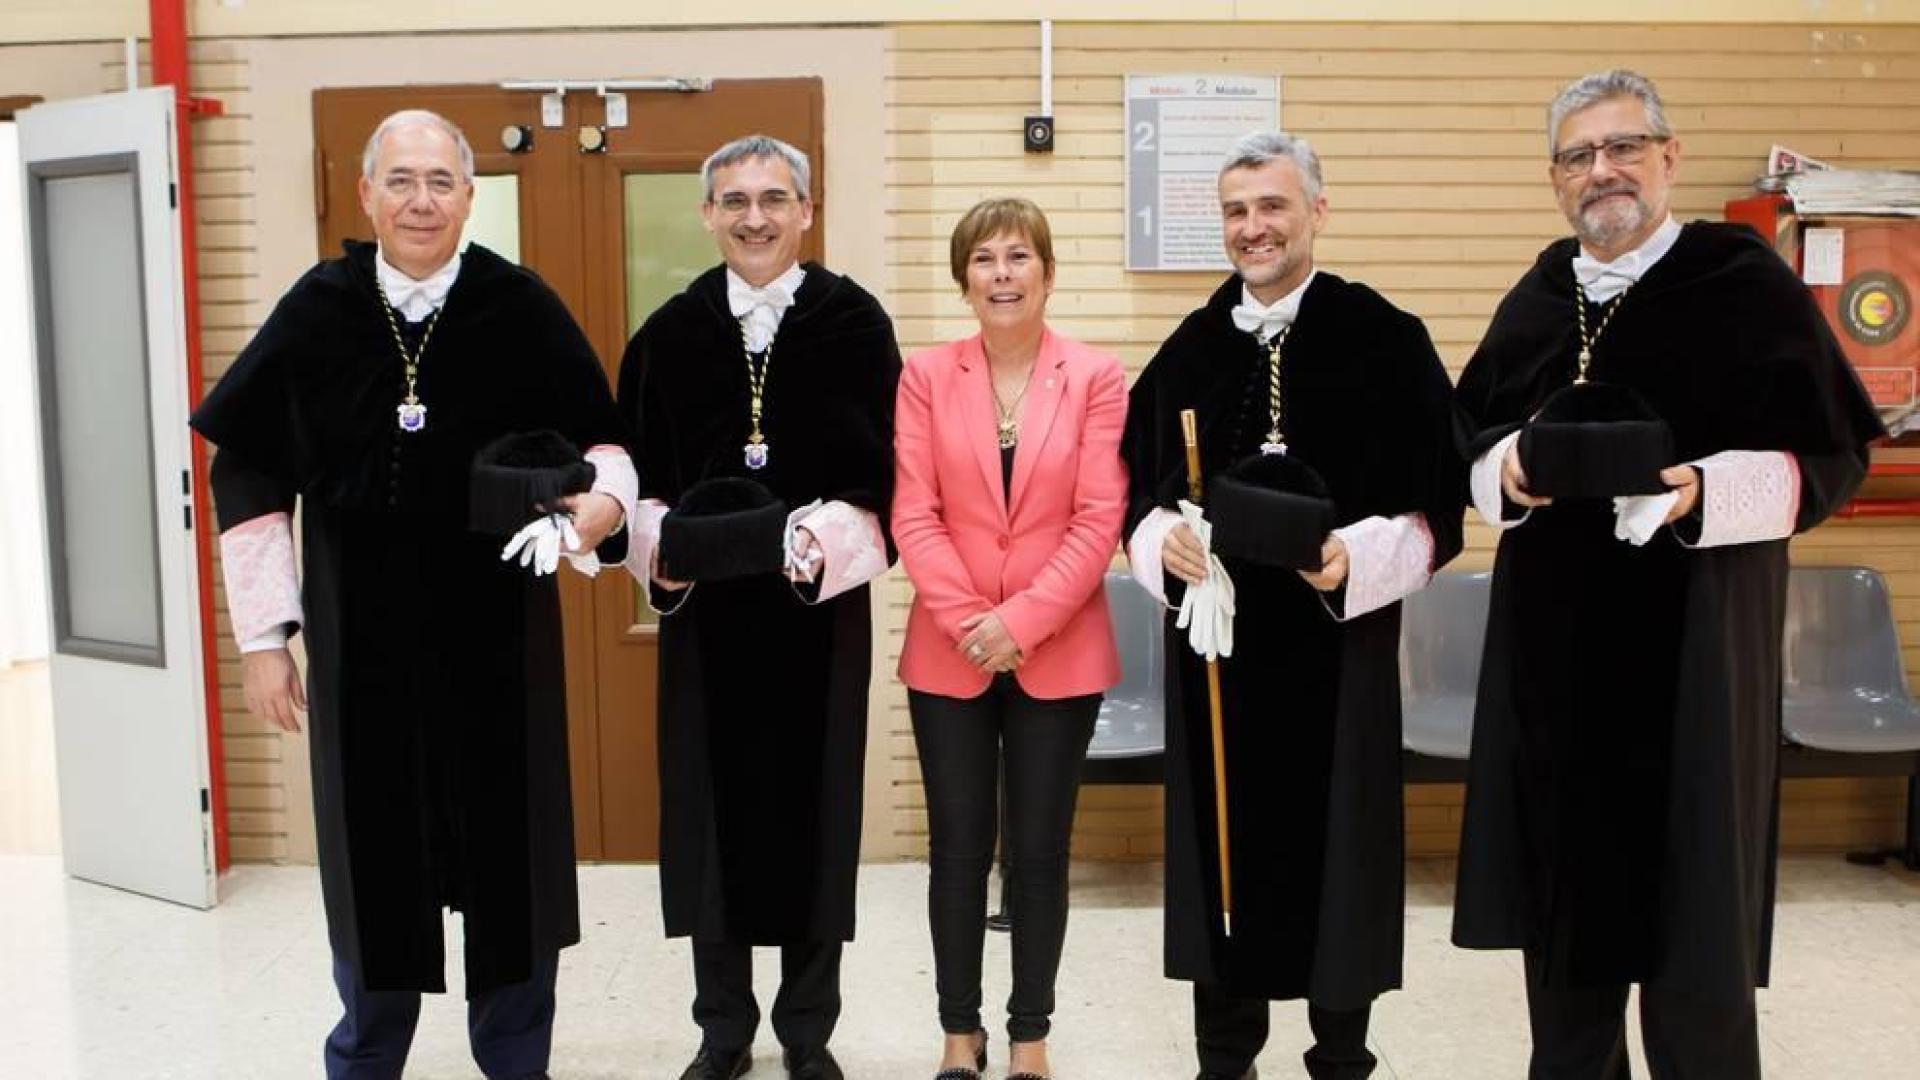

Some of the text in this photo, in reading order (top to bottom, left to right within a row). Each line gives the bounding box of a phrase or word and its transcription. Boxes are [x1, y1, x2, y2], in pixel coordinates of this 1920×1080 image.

[1195, 79, 1207, 94] 2
[1133, 122, 1154, 151] 2
[1136, 206, 1152, 235] 1
